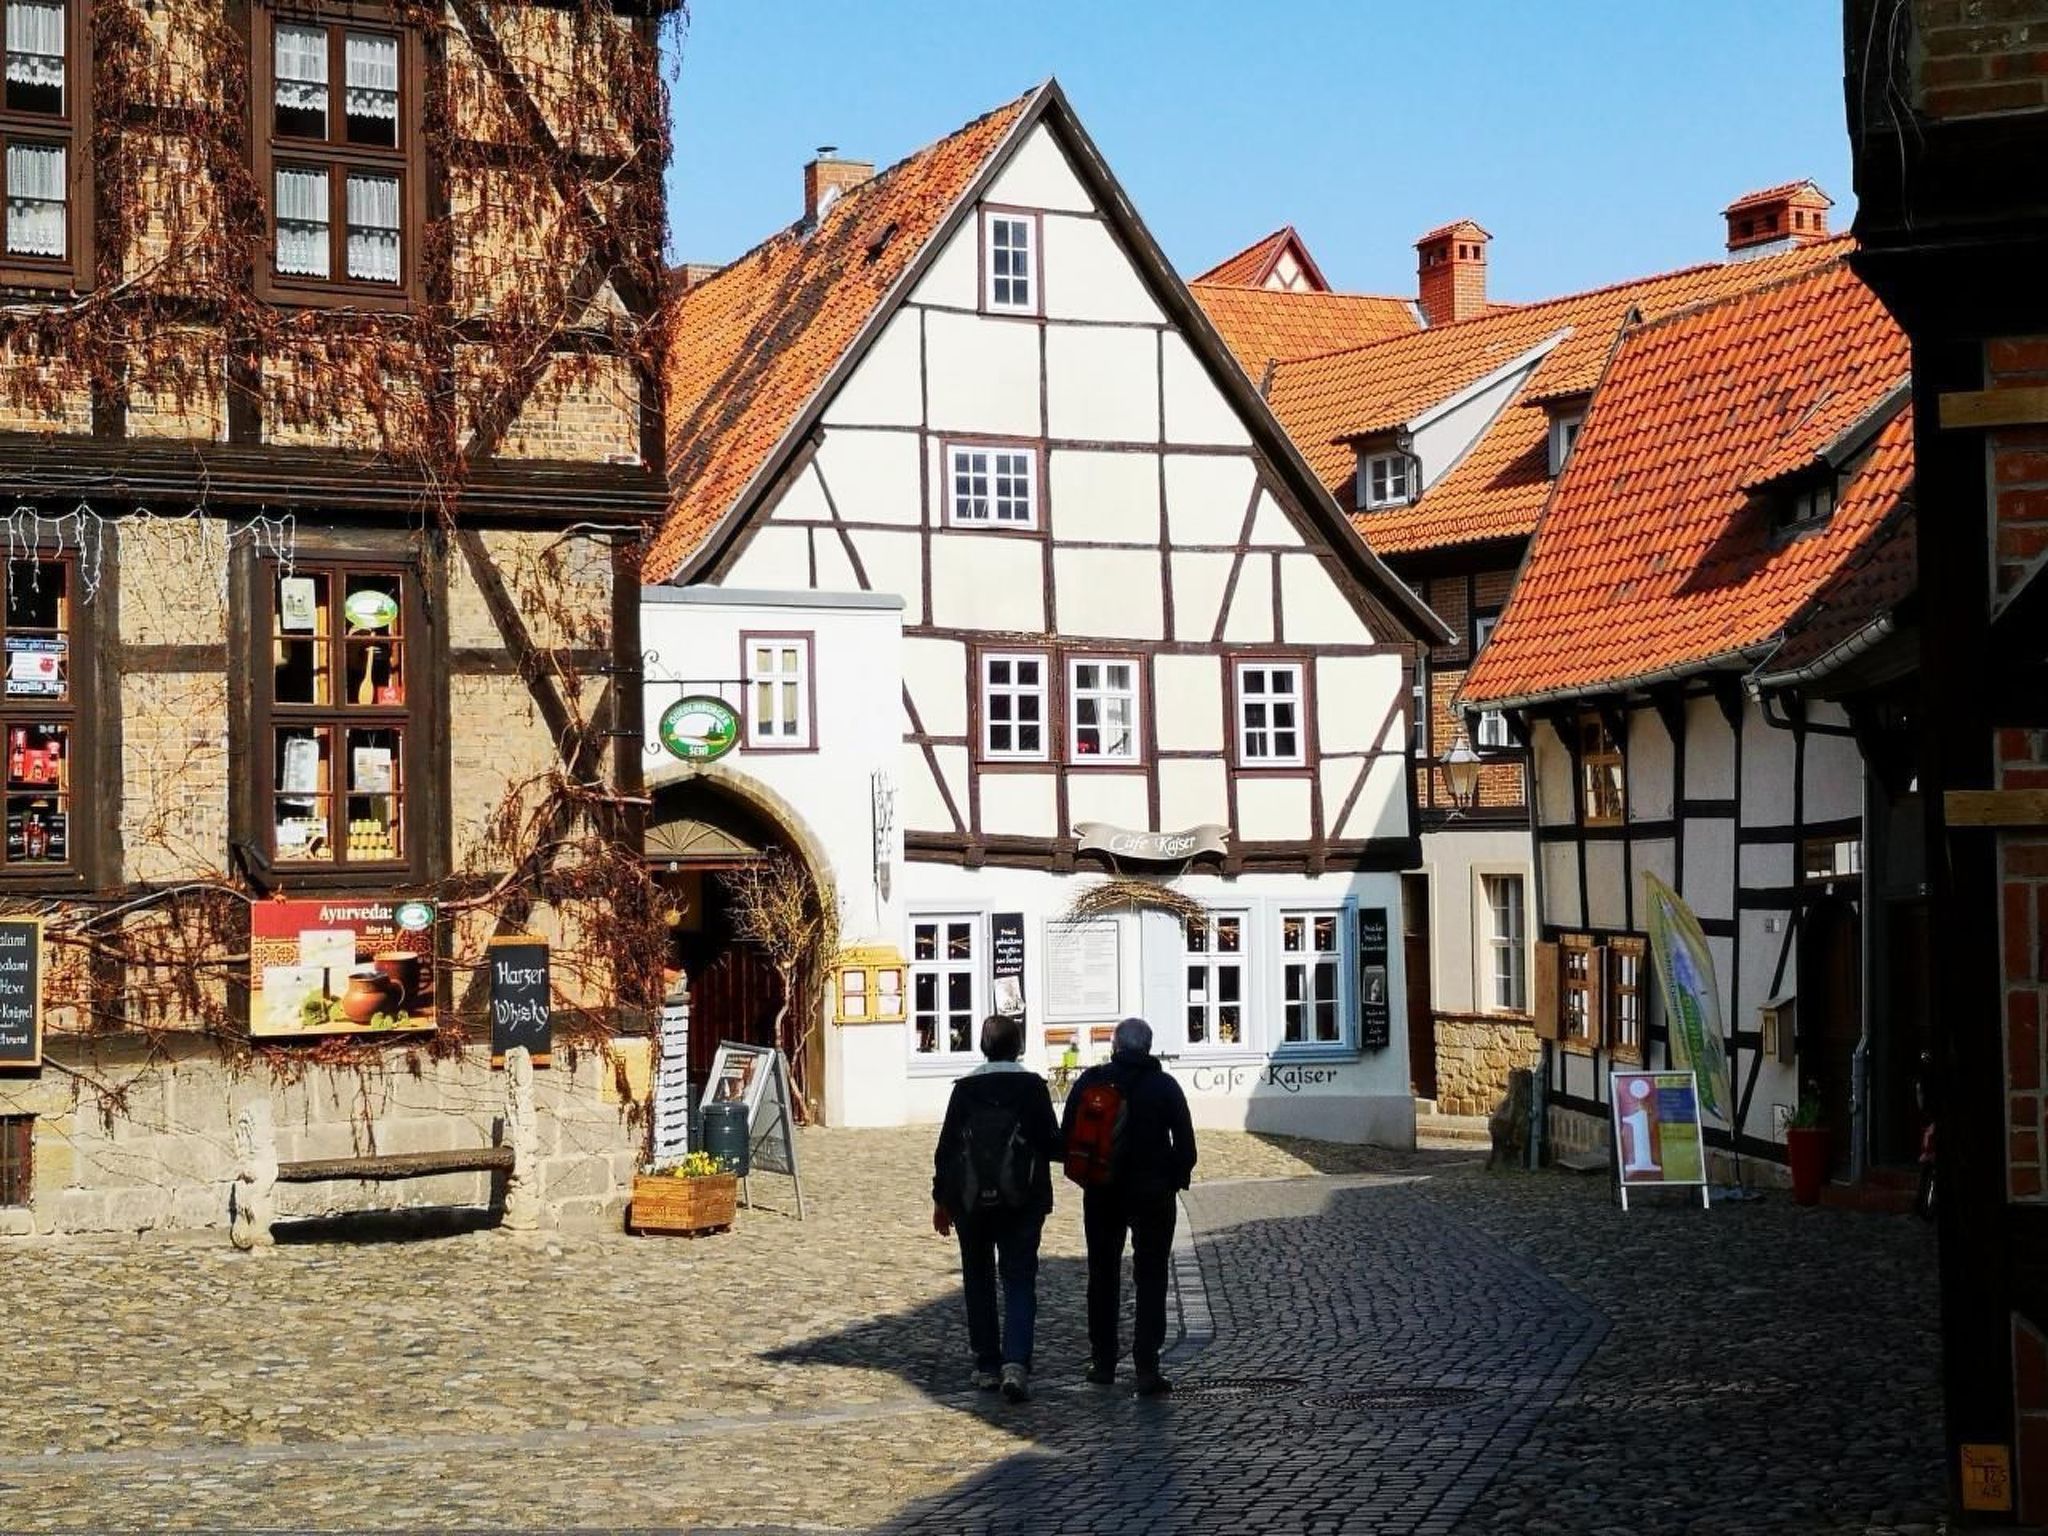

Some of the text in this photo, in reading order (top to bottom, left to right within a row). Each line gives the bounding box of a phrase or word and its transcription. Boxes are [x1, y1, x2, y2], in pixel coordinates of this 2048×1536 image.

[319, 903, 393, 926] Ayurveda:
[496, 960, 545, 992] Harzer
[494, 998, 549, 1032] Whisky
[1264, 1063, 1338, 1093] Kaiser
